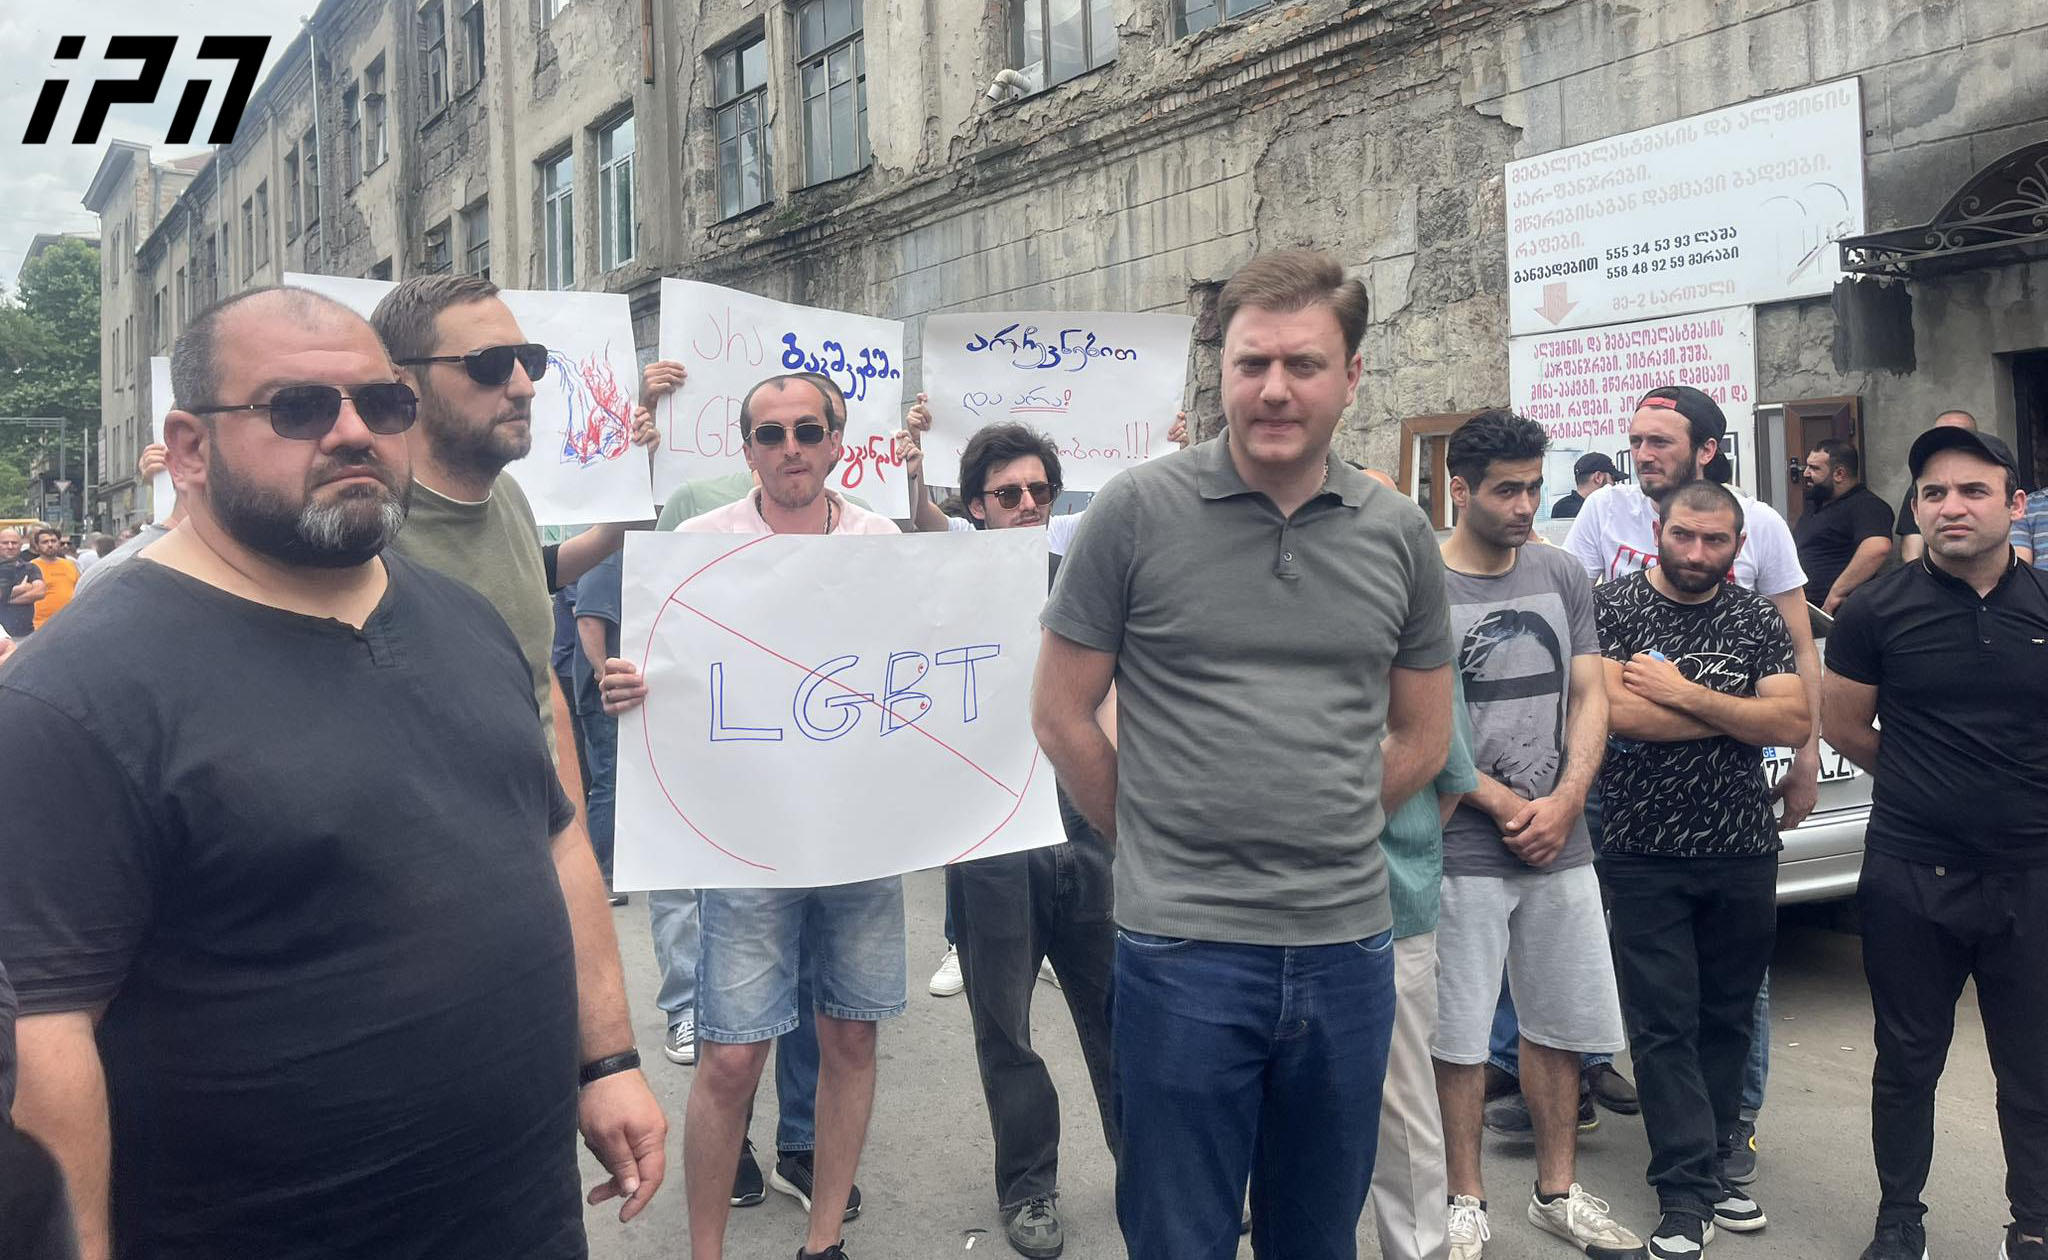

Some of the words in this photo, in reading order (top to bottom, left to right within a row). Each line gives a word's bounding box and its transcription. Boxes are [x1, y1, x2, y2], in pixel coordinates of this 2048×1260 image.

[1703, 117, 1730, 136] და
[1739, 88, 1850, 130] ალუმინის
[1643, 174, 1726, 206] დამცავი
[1606, 248, 1629, 261] 555
[1632, 242, 1650, 255] 34
[1654, 239, 1670, 251] 53
[1674, 235, 1691, 248] 93
[1694, 226, 1737, 244] ლაშა
[1514, 256, 1598, 284] განვადებით
[1606, 265, 1628, 279] 558
[1632, 261, 1648, 275] 48
[1651, 258, 1667, 272] 92
[1670, 255, 1685, 269] 59
[1688, 246, 1739, 266] მერაბი
[1612, 298, 1646, 311] მე-2
[1651, 279, 1736, 305] სართული
[966, 323, 1137, 371] არჩევნებით
[1534, 338, 1583, 359] ალუმინის
[1587, 335, 1601, 353] და
[1605, 319, 1724, 351] მეტალოპლასტმასის
[1602, 368, 1675, 393] მწერებისგან
[1680, 363, 1730, 385] დამცავი
[1731, 384, 1748, 402] და
[964, 390, 1002, 416] და
[669, 393, 745, 458] LGB
[1544, 418, 1614, 440] ერტიკალური
[710, 645, 1000, 741] LGBT
[1762, 747, 1776, 758] GE
